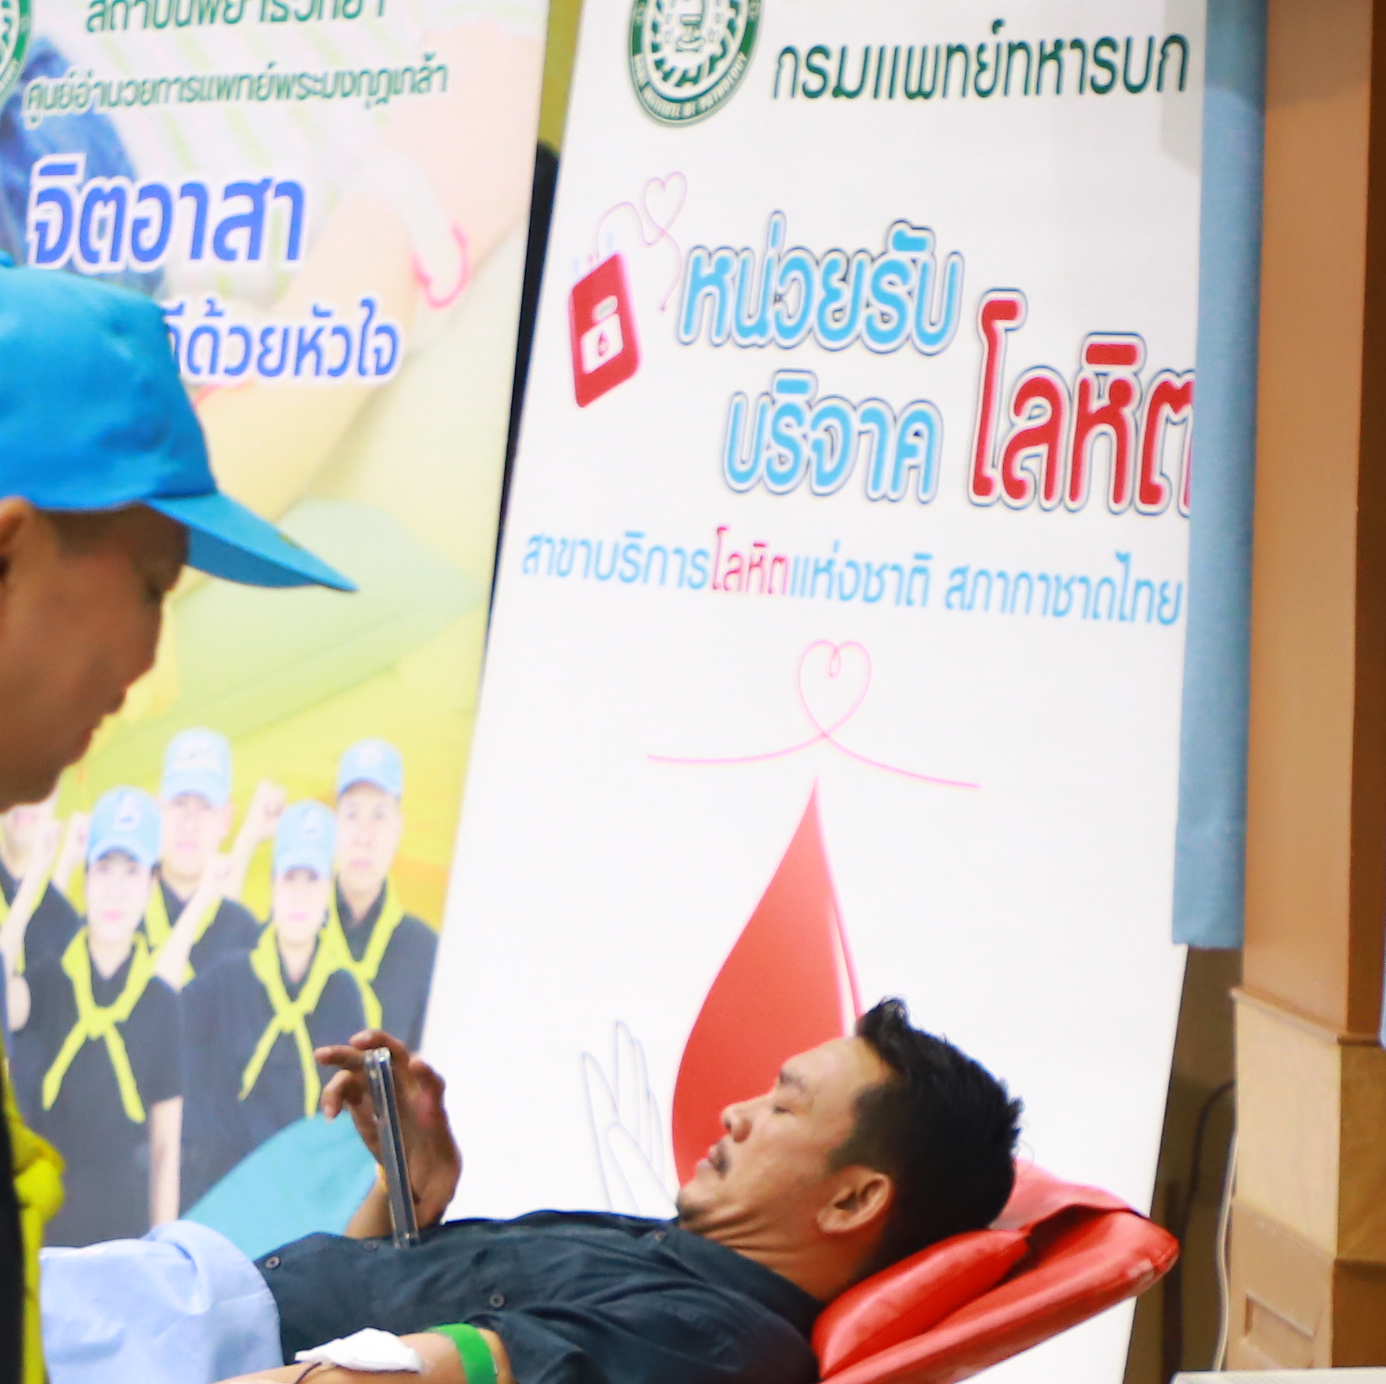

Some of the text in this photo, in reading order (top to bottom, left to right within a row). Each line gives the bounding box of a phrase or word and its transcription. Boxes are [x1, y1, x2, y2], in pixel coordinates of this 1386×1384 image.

[85, 0, 387, 34] สถาบนพยาธวทยา
[774, 19, 1190, 99] กรมแพทย์ทหารบก
[31, 158, 306, 266] จิตอาสา
[678, 214, 962, 351] หน่วยรับ
[726, 372, 941, 499] บริจาค
[521, 525, 1182, 625] สาขาบริการโลหิตแห่งชาติ สภากาชาดไทย
